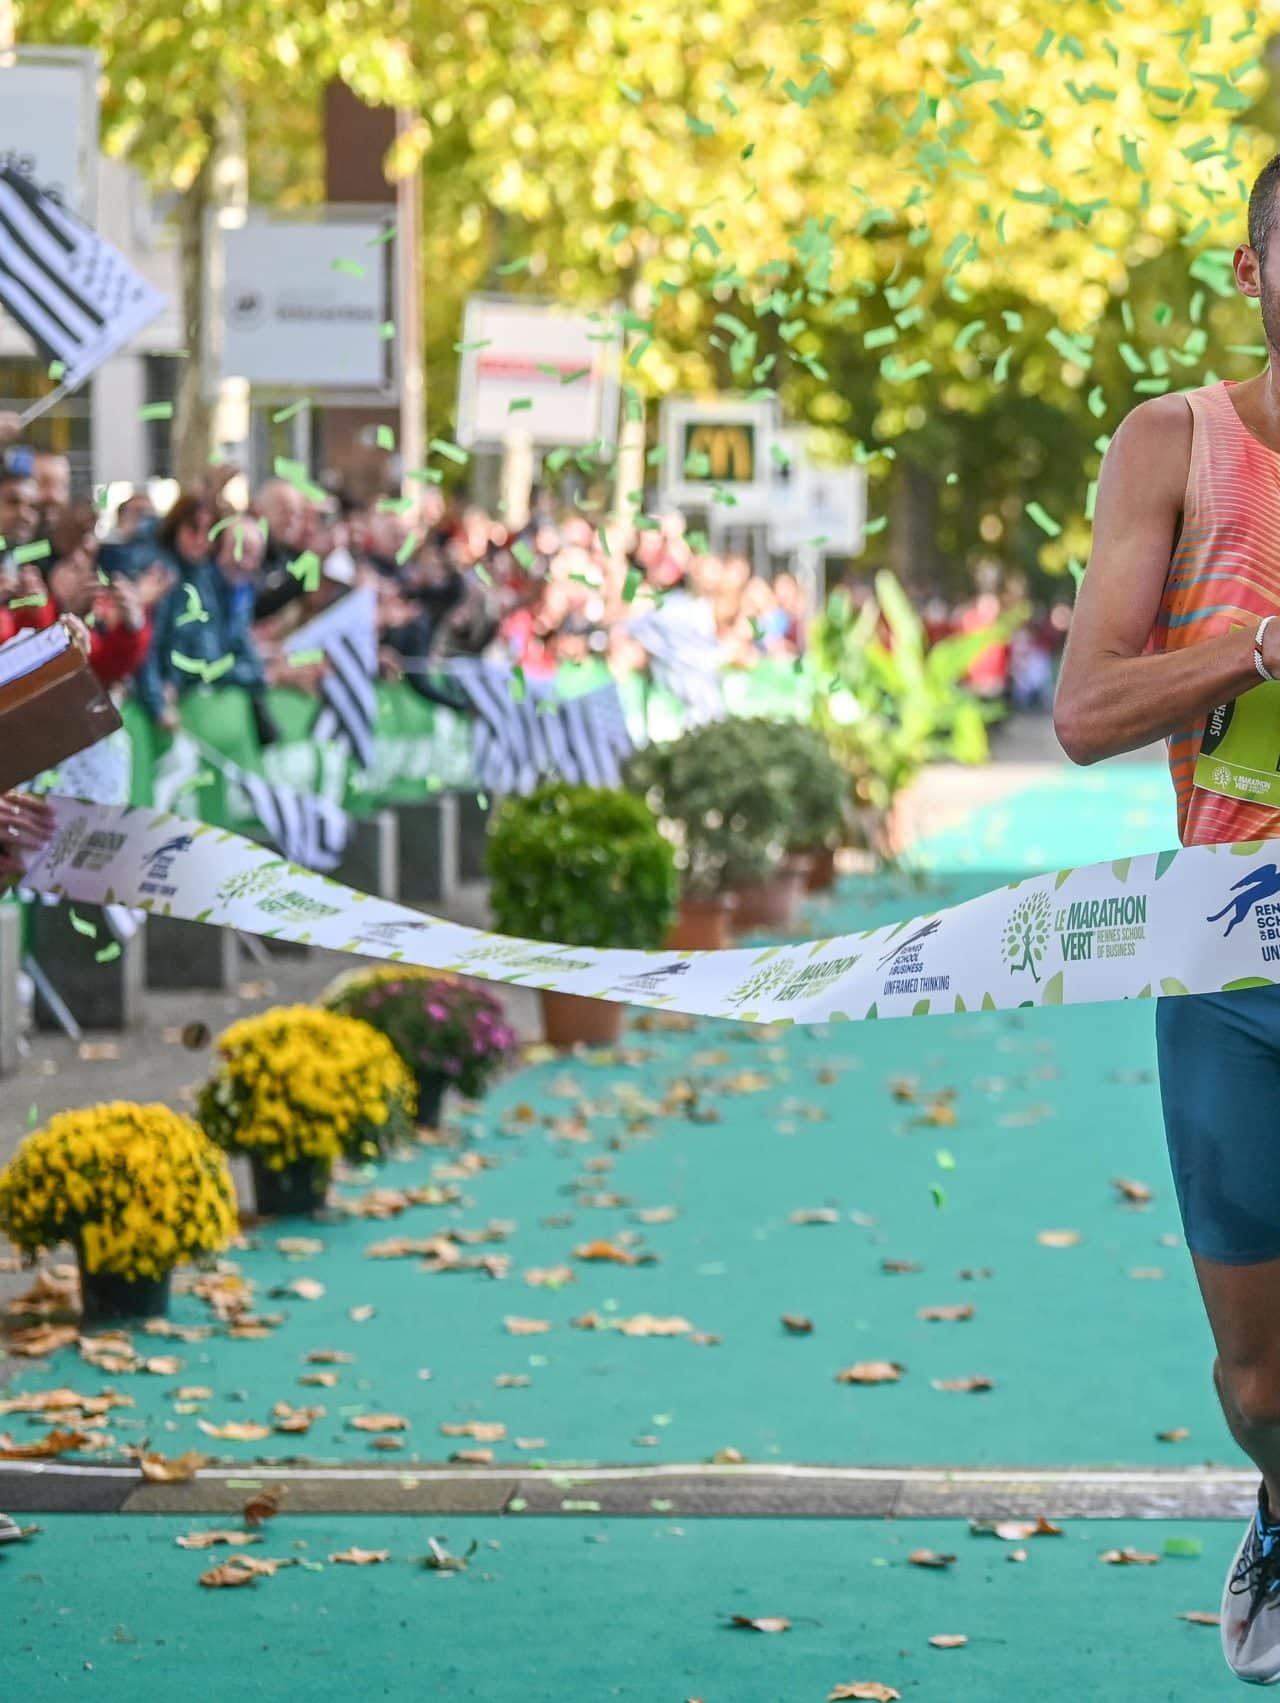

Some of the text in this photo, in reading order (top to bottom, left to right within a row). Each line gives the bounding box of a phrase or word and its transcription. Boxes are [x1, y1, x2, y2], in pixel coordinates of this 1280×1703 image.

[1055, 895, 1147, 932] LE MARATHON
[1122, 926, 1145, 941] SCHOOL
[1060, 931, 1093, 961] VERT
[1106, 942, 1135, 958] BUSINESS
[884, 976, 950, 995] UNFRAMED THINKING
